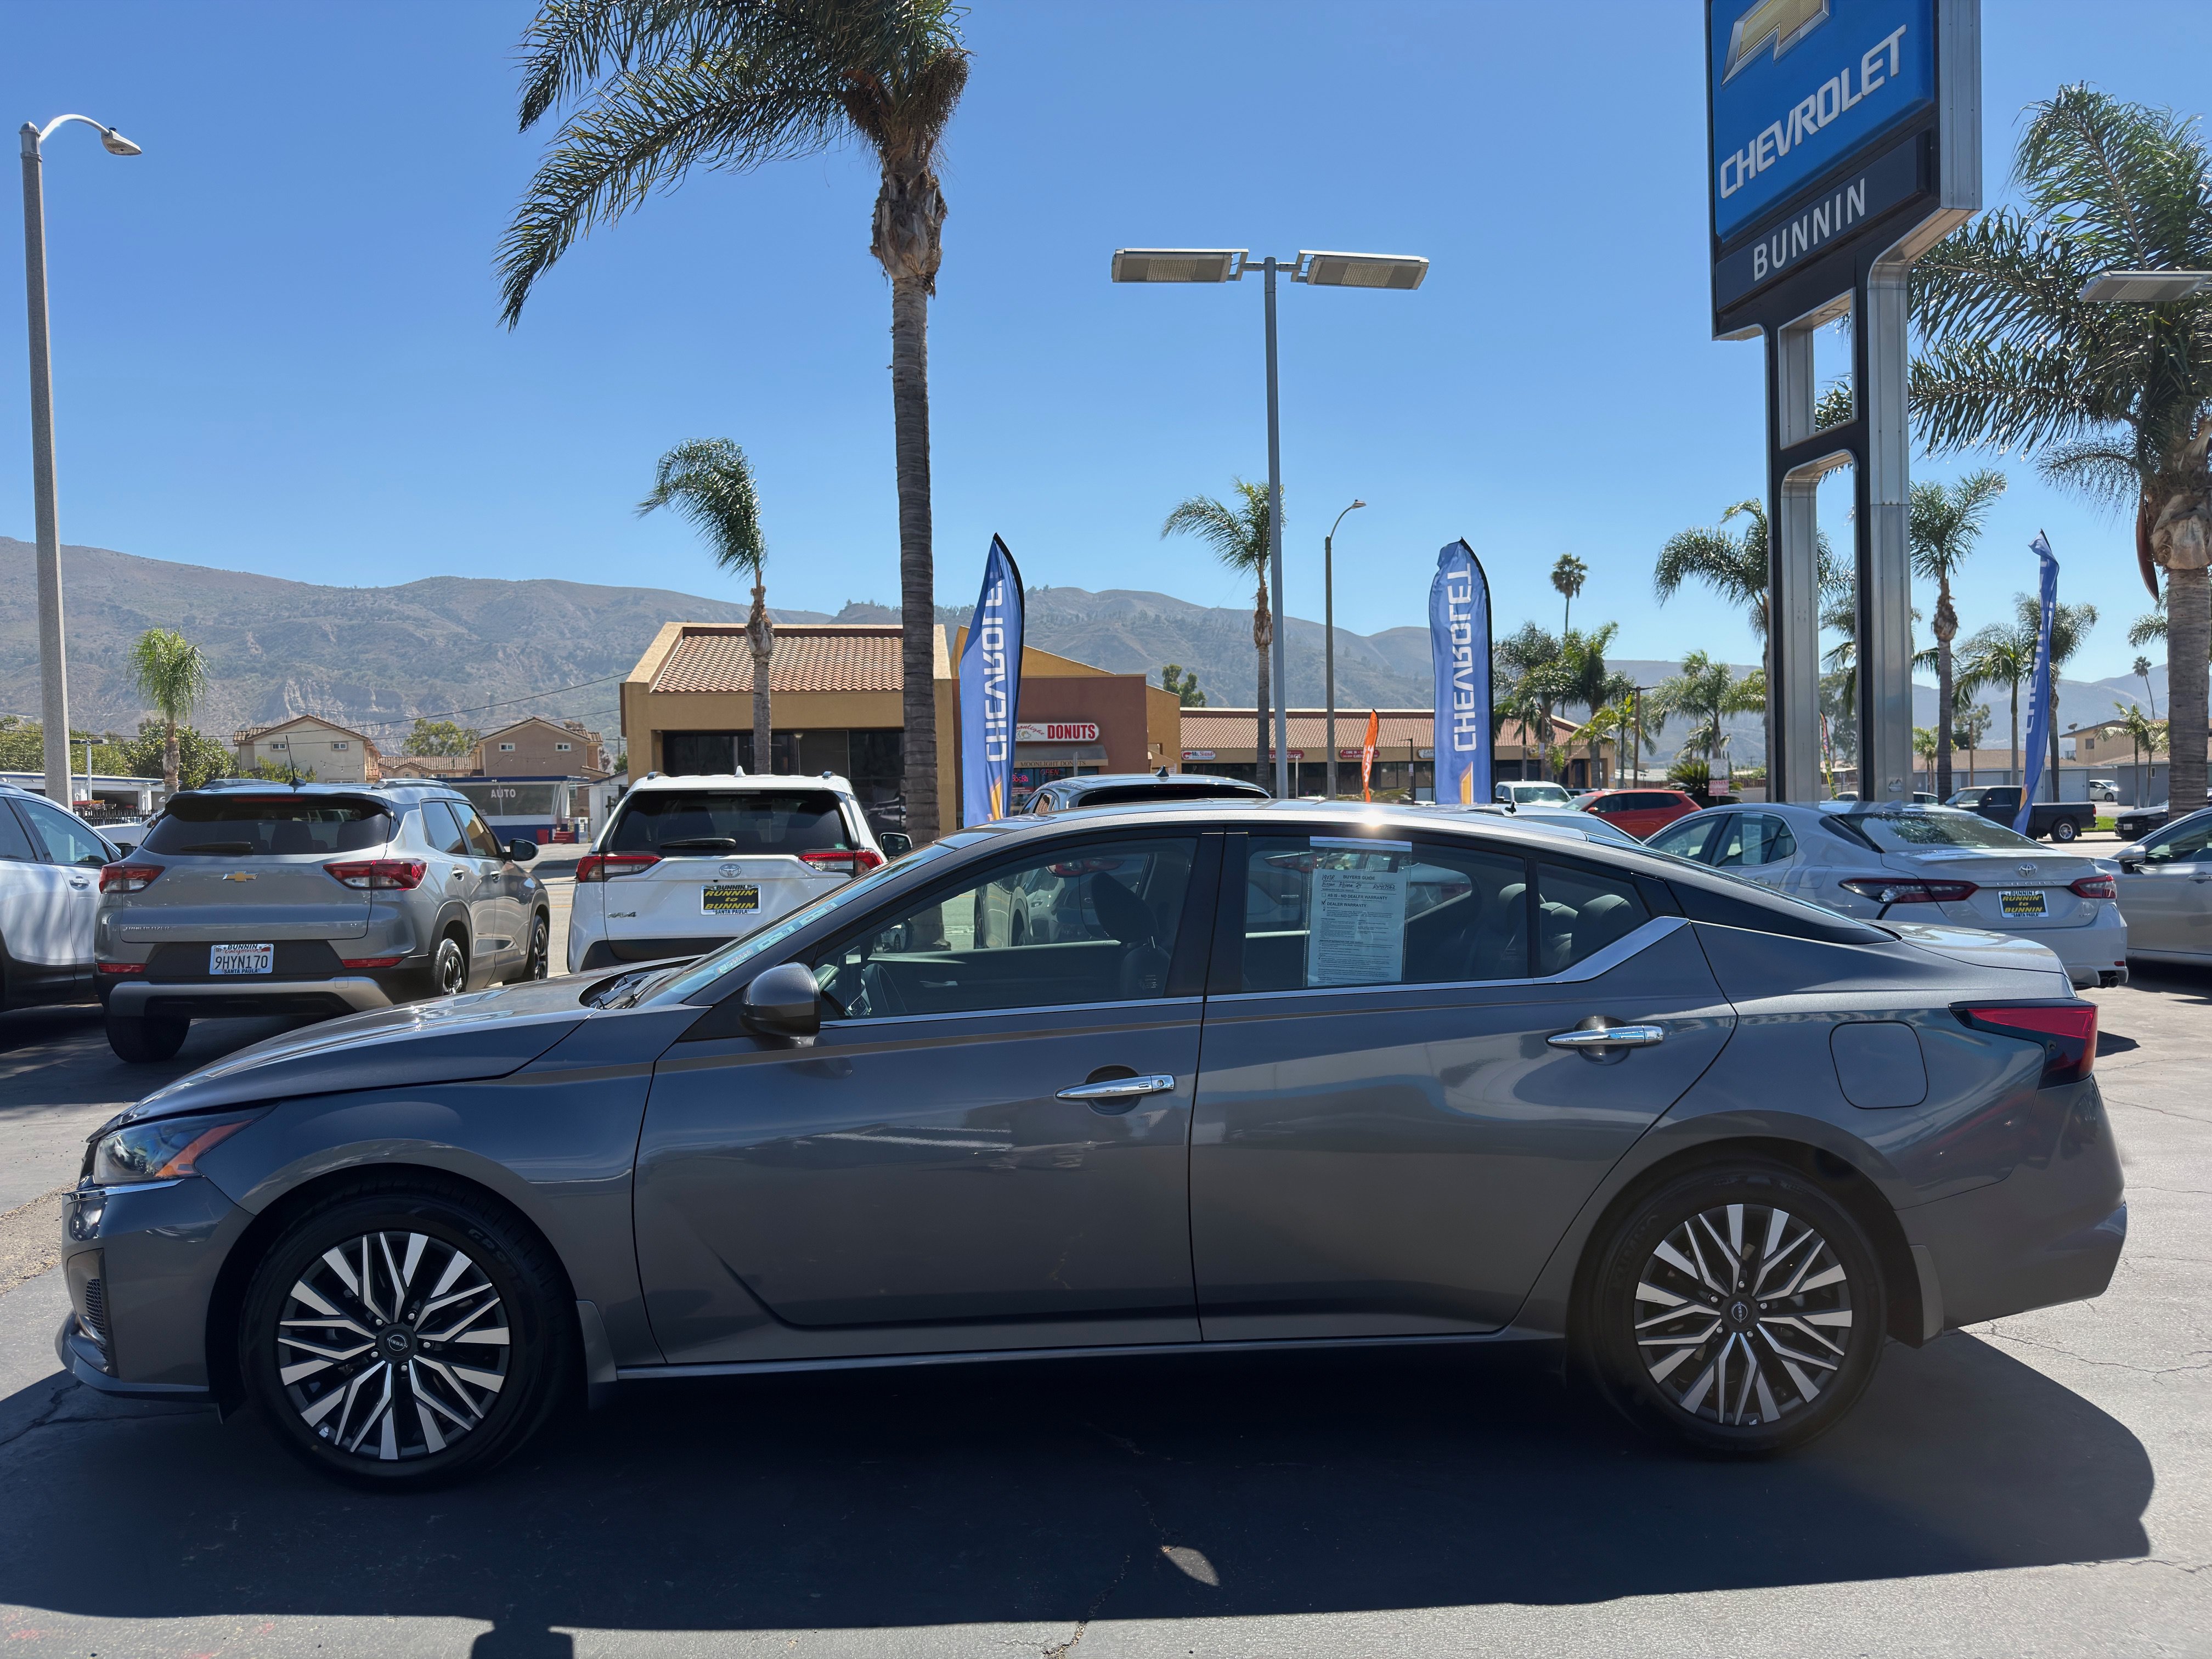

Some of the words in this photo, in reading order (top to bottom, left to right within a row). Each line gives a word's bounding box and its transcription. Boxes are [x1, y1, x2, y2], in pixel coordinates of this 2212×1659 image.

[1720, 24, 1907, 200] CHEVROLET
[1753, 177, 1866, 282] BUNNIN
[1047, 724, 1096, 740] DONUTS
[490, 788, 516, 798] AUTO
[214, 955, 269, 970] 9HYN170
[387, 1337, 408, 1348] NISSAN
